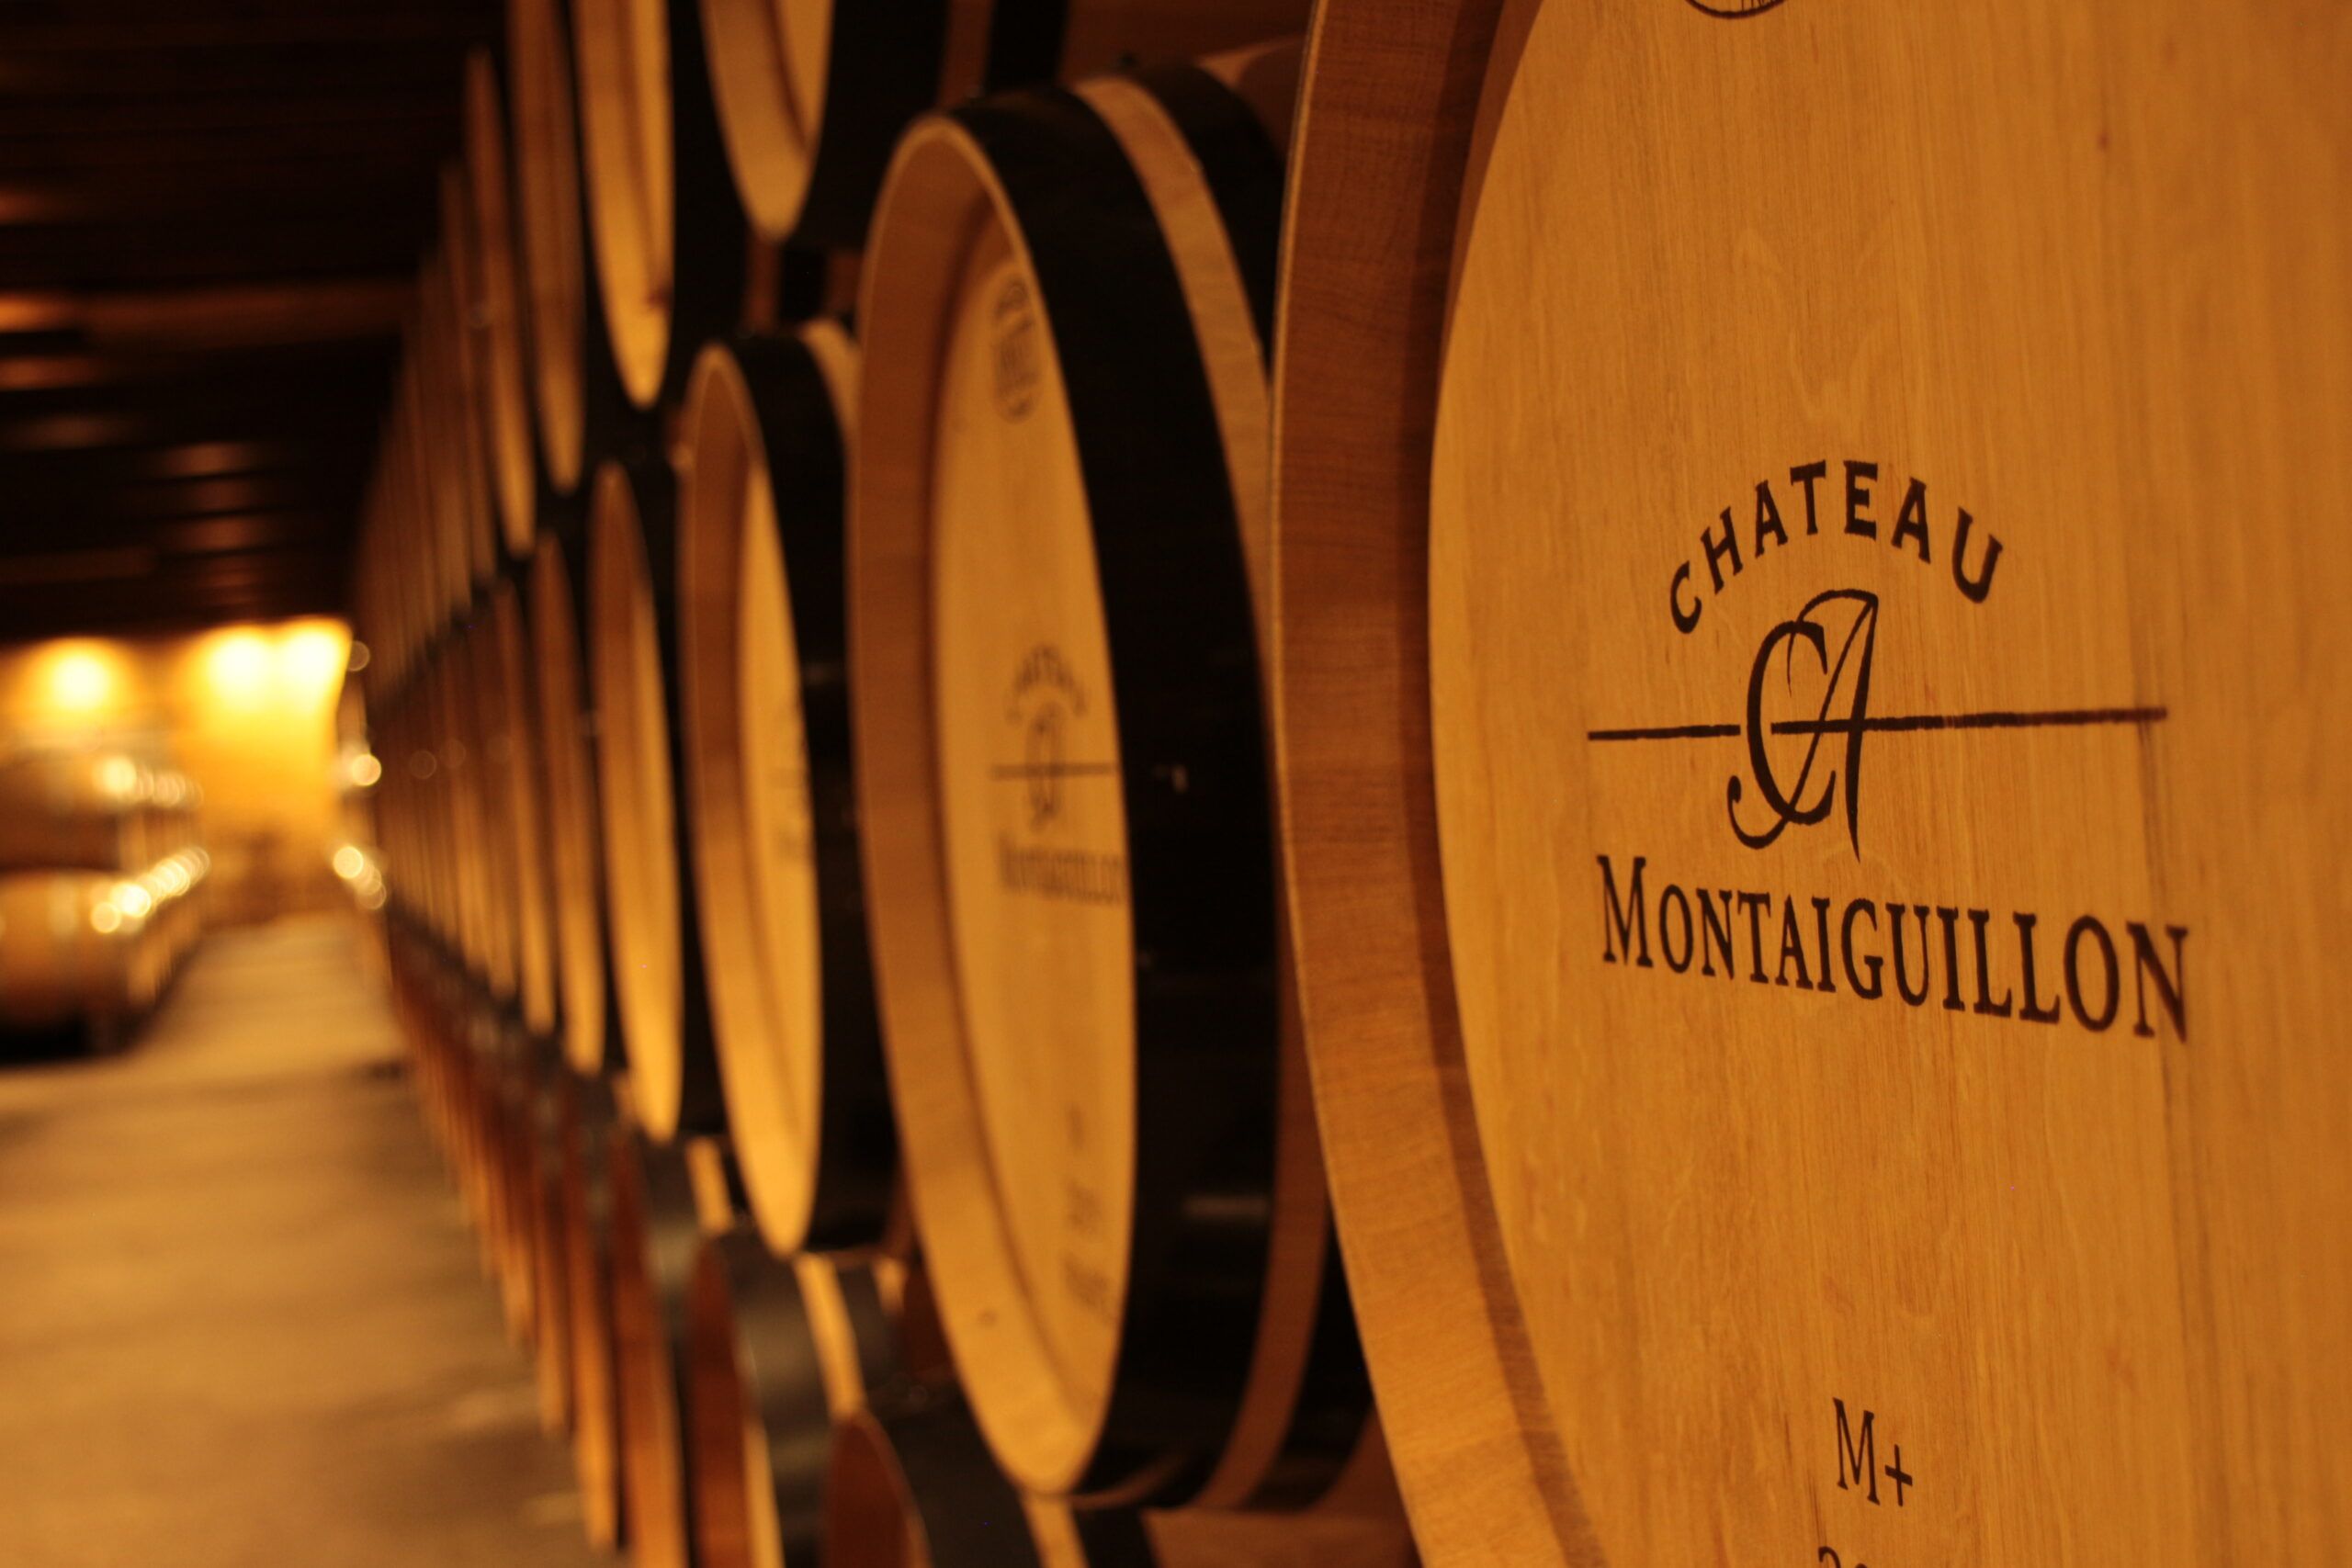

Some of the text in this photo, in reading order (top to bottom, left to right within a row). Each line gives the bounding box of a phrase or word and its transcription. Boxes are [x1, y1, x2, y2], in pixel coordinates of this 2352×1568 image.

[1668, 460, 2003, 634] CHATEAU
[1596, 855, 2188, 1043] MONTAIGUILLON
[1833, 1397, 1913, 1507] M+
